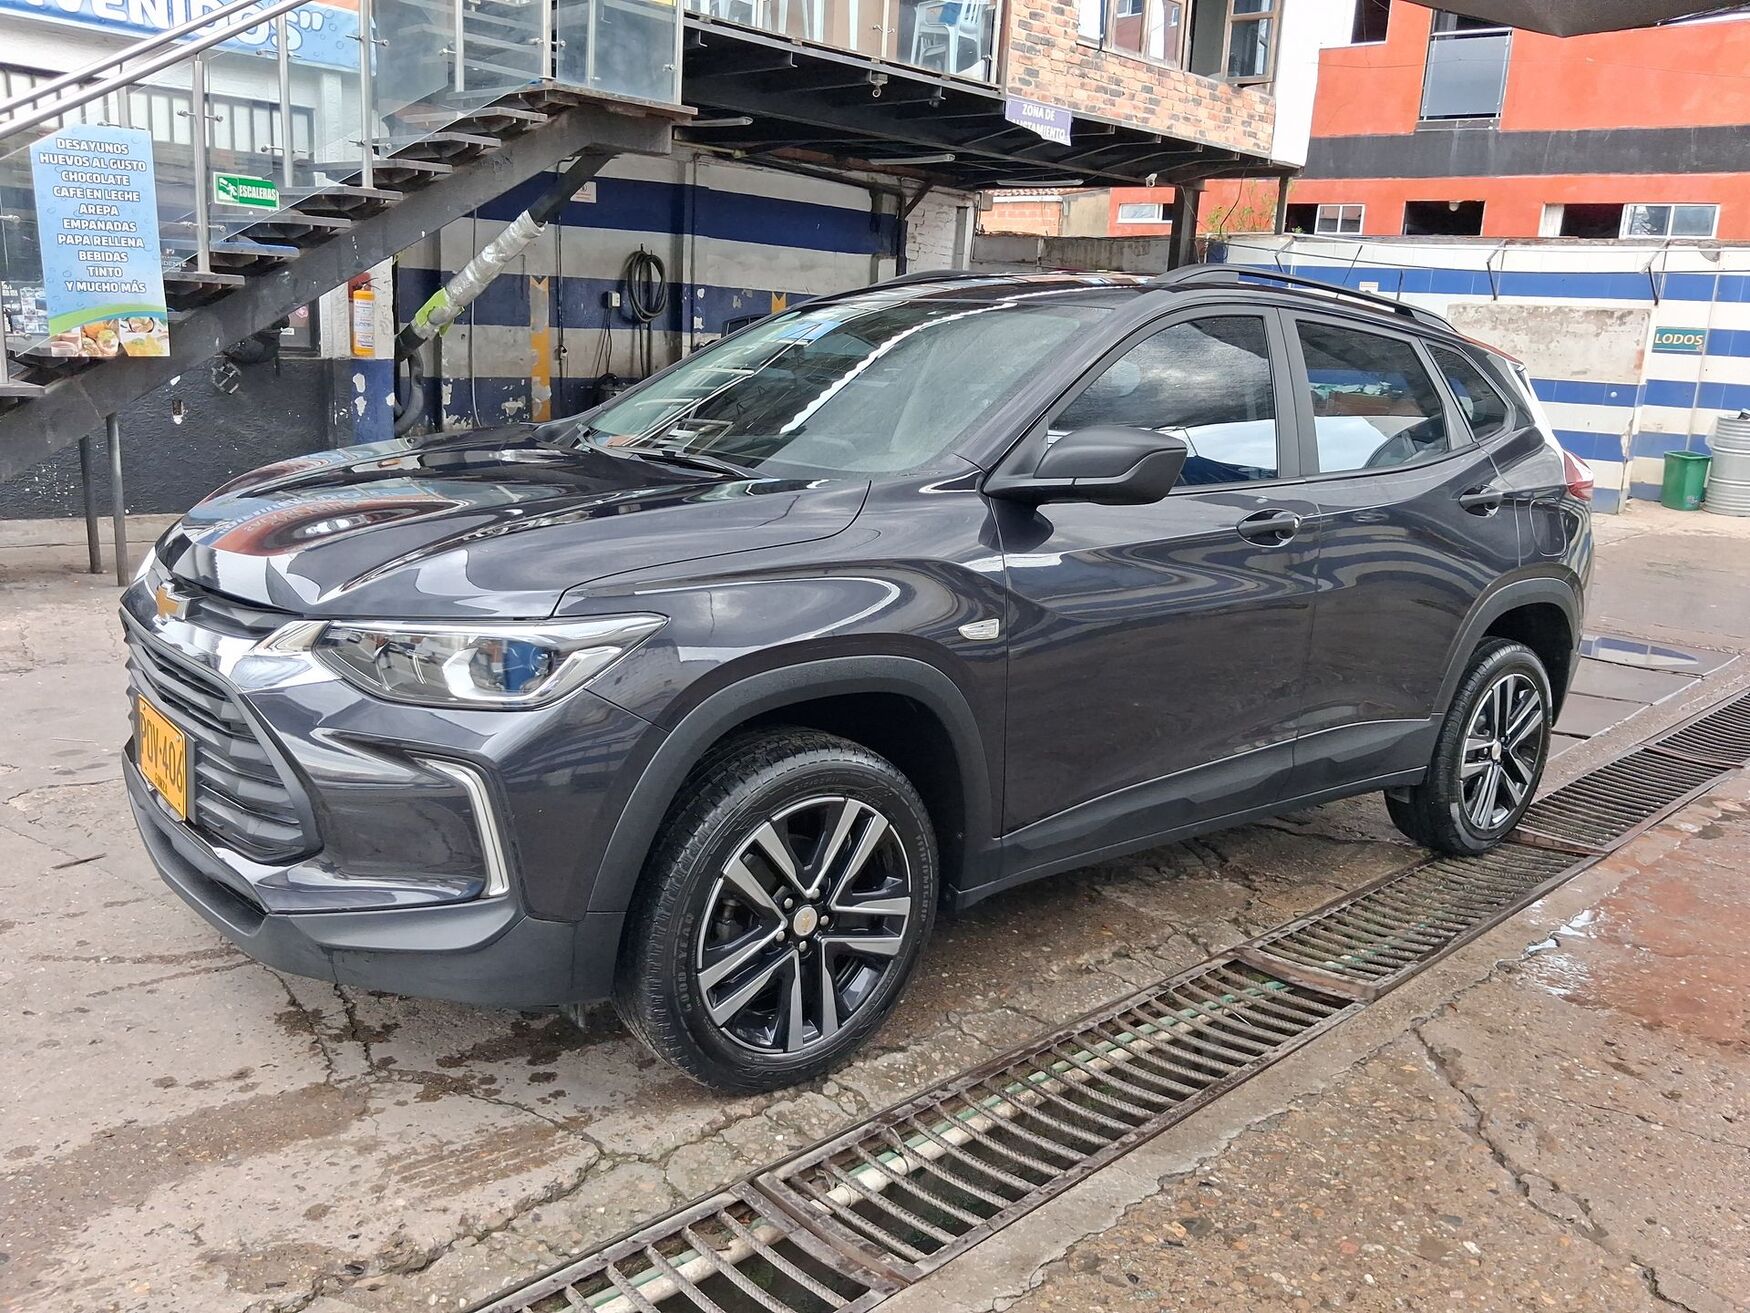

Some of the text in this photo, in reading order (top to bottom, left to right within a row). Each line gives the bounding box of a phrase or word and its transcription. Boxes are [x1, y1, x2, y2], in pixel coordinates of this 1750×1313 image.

[1022, 104, 1056, 121] ZONA DE
[56, 138, 129, 154] DESAYUNOS
[39, 153, 147, 171] HUEVOS AL GUSTO
[61, 170, 130, 186] CHOCOLATE
[53, 186, 140, 202] CAFE EN LECHE
[240, 185, 276, 200] ESCALERAS
[79, 203, 119, 216] AREPA
[63, 218, 137, 232] EMPANADAS
[57, 233, 144, 248] PAPA RELLENA
[78, 250, 128, 262] BEBIDAS
[86, 266, 123, 277] TINTO
[65, 280, 146, 293] Y MUCHO MÁS
[1655, 333, 1704, 345] LODOS
